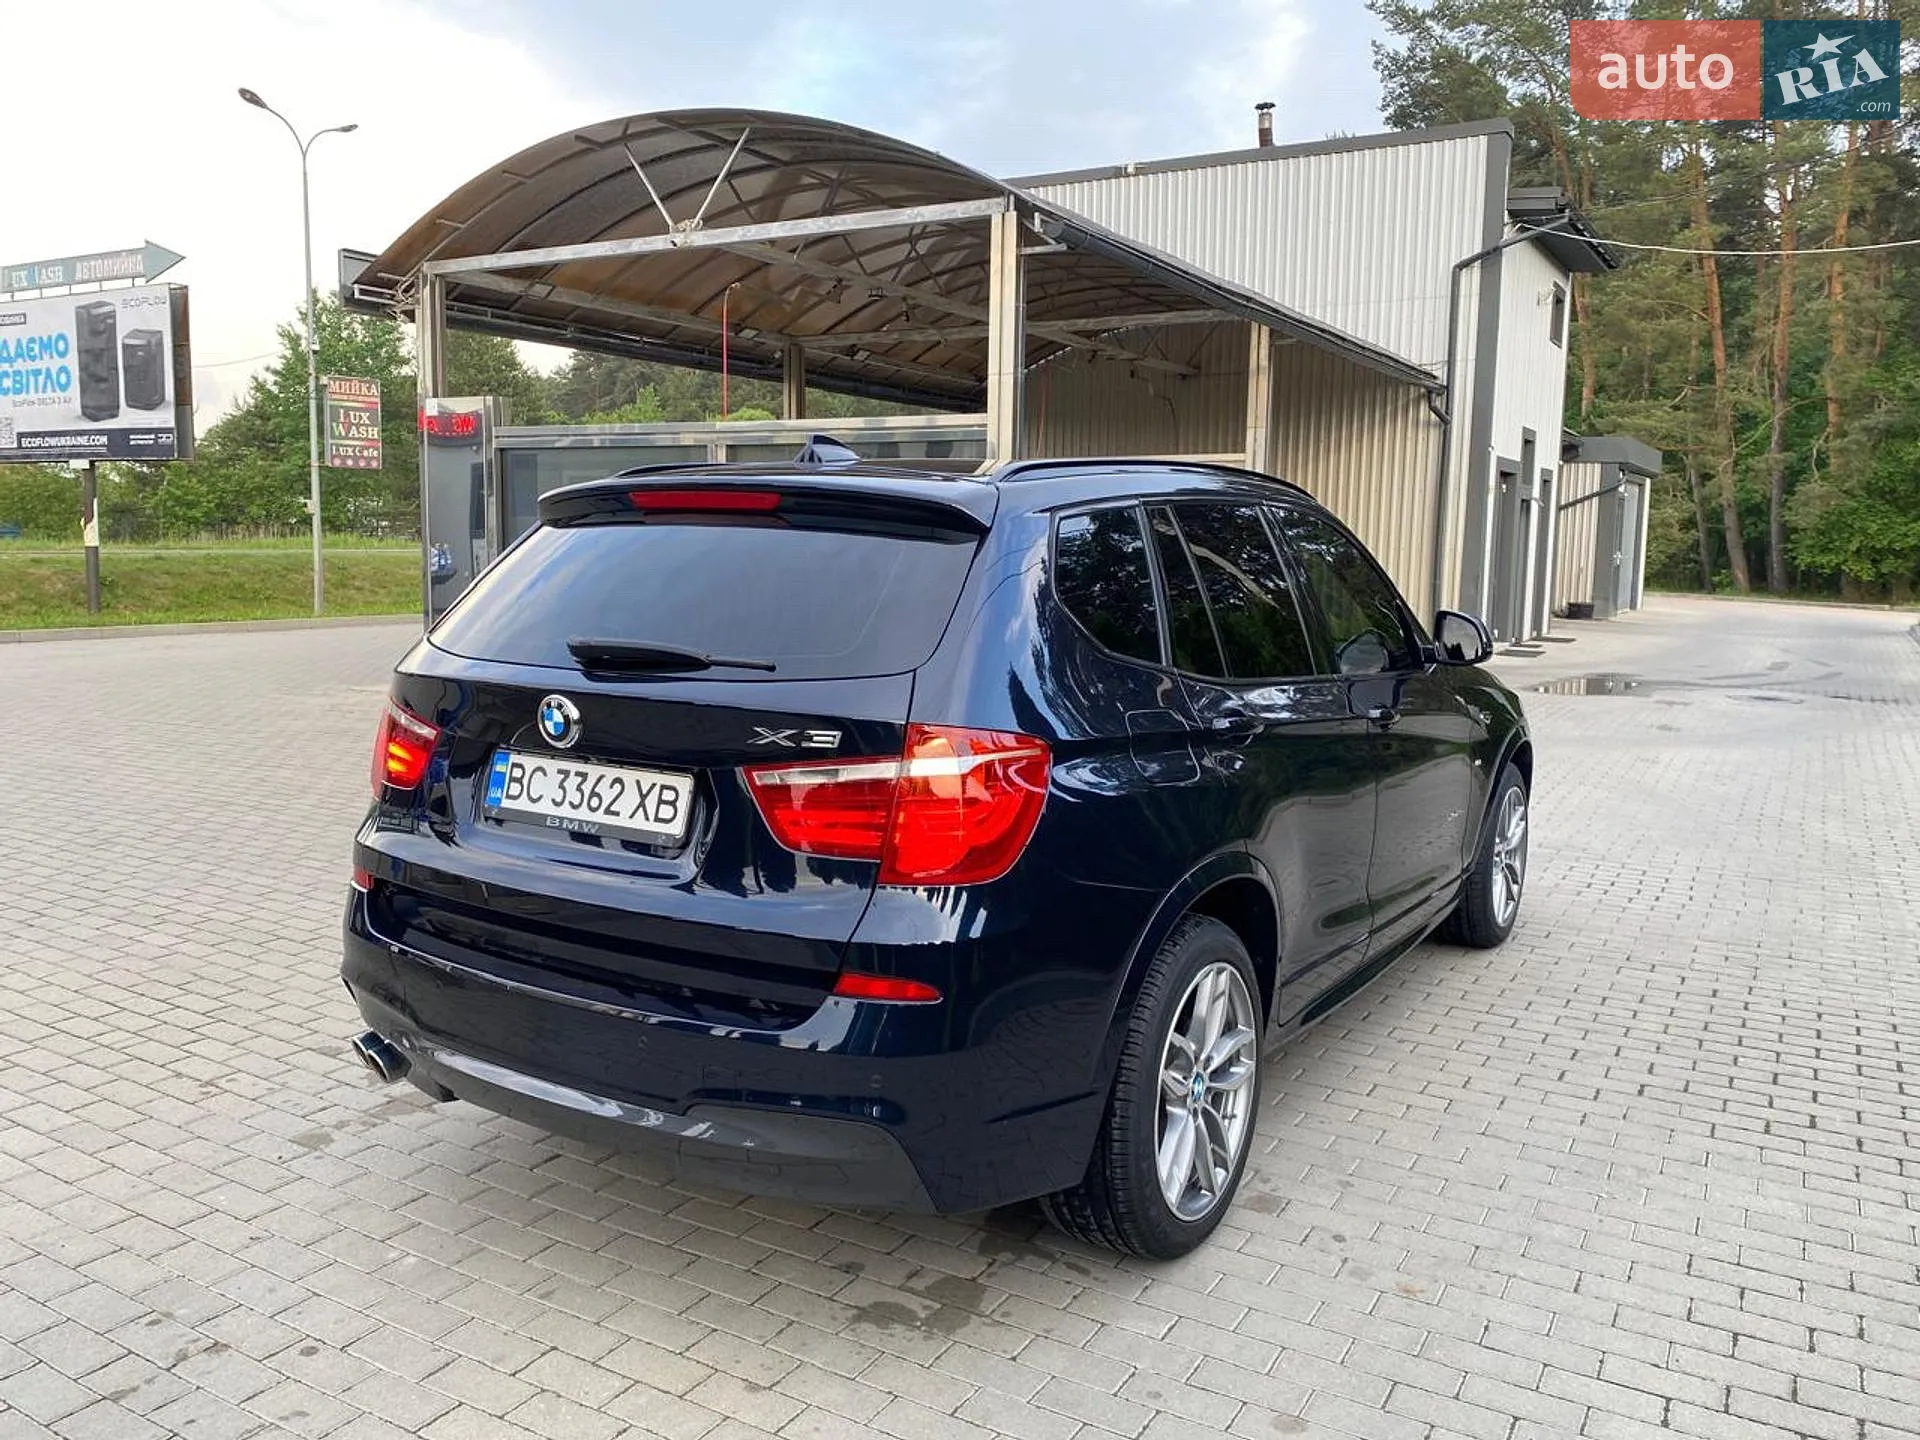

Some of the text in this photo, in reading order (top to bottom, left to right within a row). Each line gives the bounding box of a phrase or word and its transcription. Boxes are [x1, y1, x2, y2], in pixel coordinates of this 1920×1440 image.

[329, 380, 378, 395] МИЙКА
[340, 408, 371, 424] LUX
[332, 421, 379, 439] WASH
[505, 762, 680, 825] BC 3362 XB
[546, 816, 600, 834] BMW
